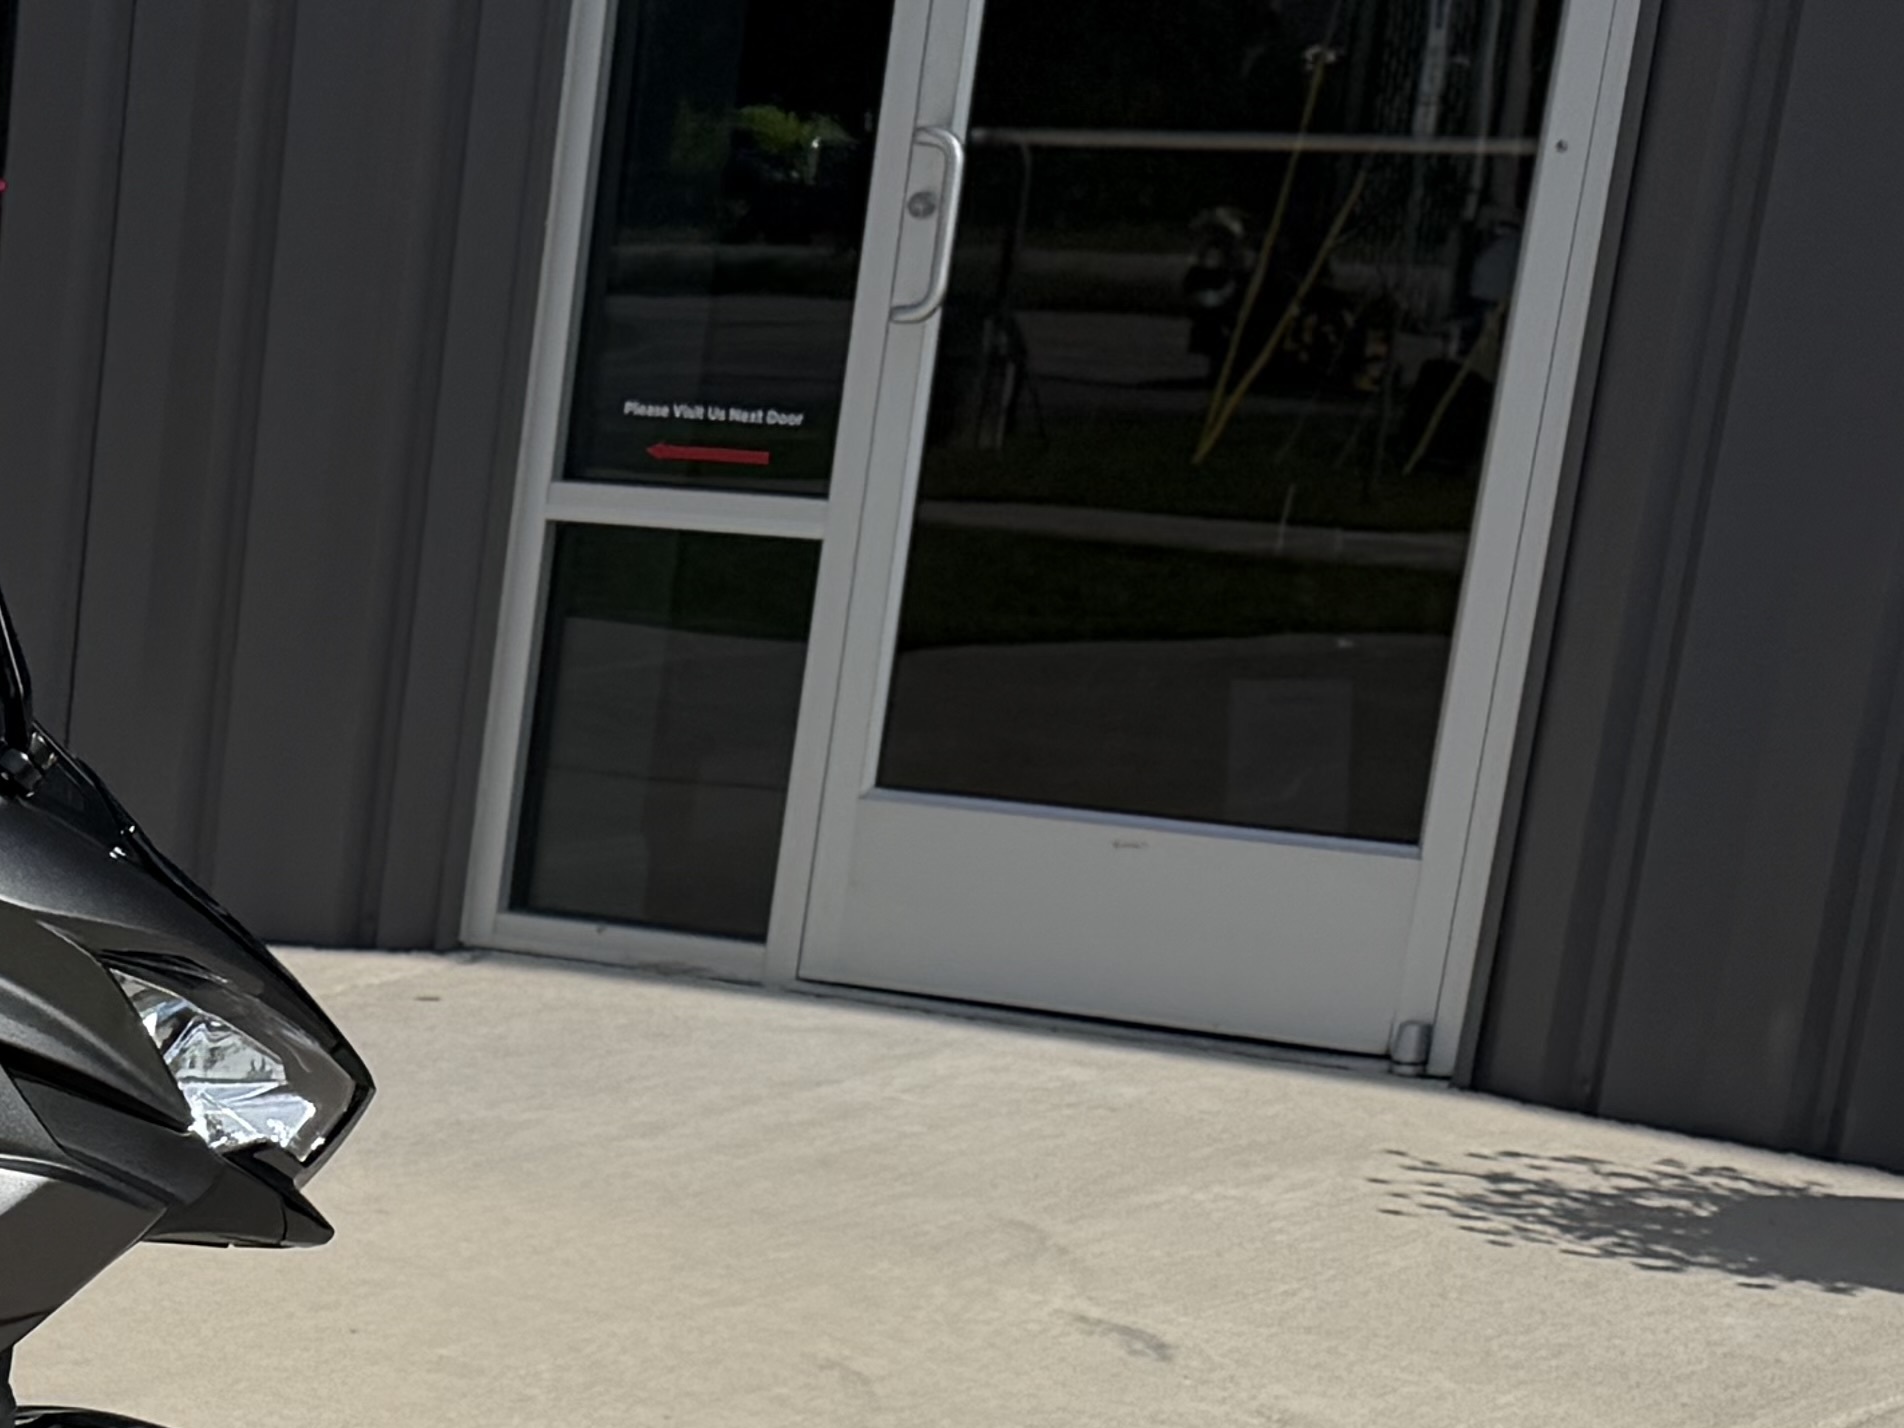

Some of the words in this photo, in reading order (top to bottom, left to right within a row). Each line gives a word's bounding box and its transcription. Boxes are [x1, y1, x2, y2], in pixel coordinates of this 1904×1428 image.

[623, 401, 670, 418] Please
[673, 403, 705, 420] Visit
[707, 405, 726, 421] Us
[728, 407, 764, 424] Next
[765, 409, 804, 426] Door
